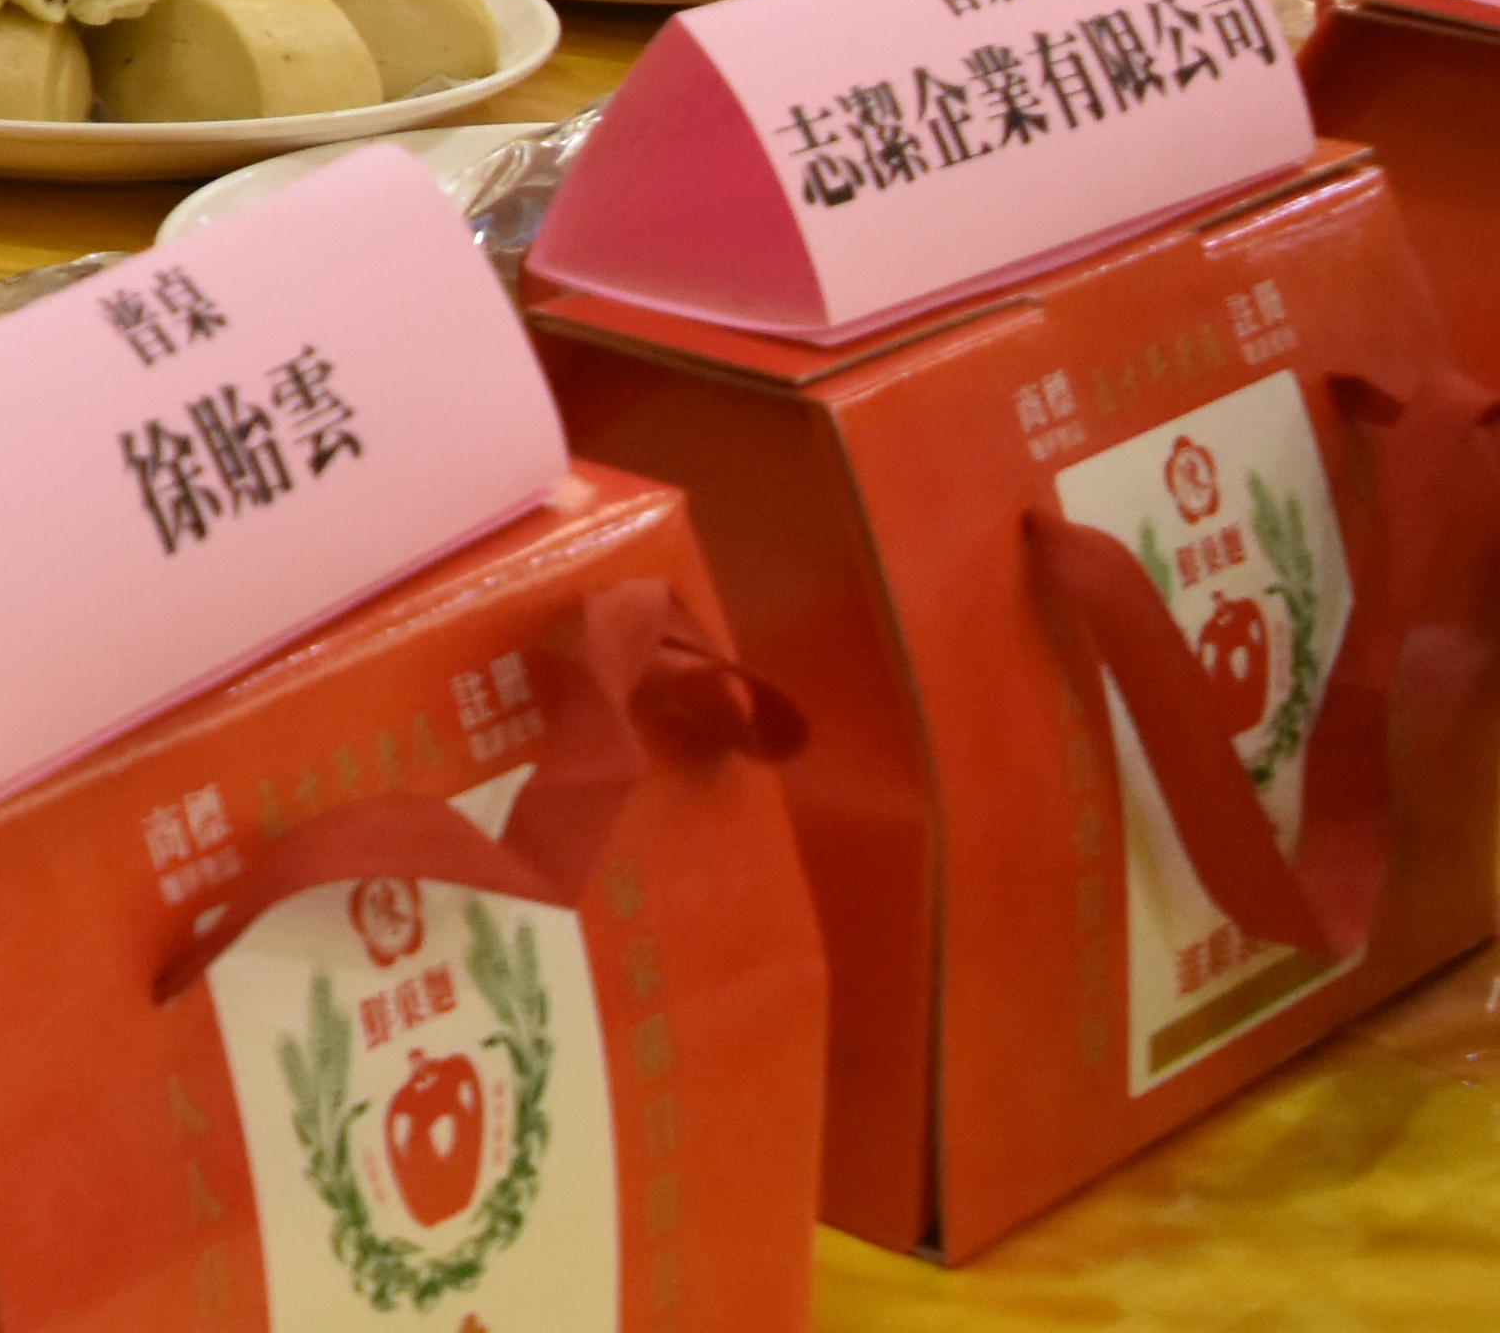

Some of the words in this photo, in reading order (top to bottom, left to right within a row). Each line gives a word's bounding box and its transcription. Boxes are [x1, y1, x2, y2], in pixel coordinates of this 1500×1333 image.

[97, 265, 227, 366] 普桌
[118, 344, 365, 556] 徐貽雲
